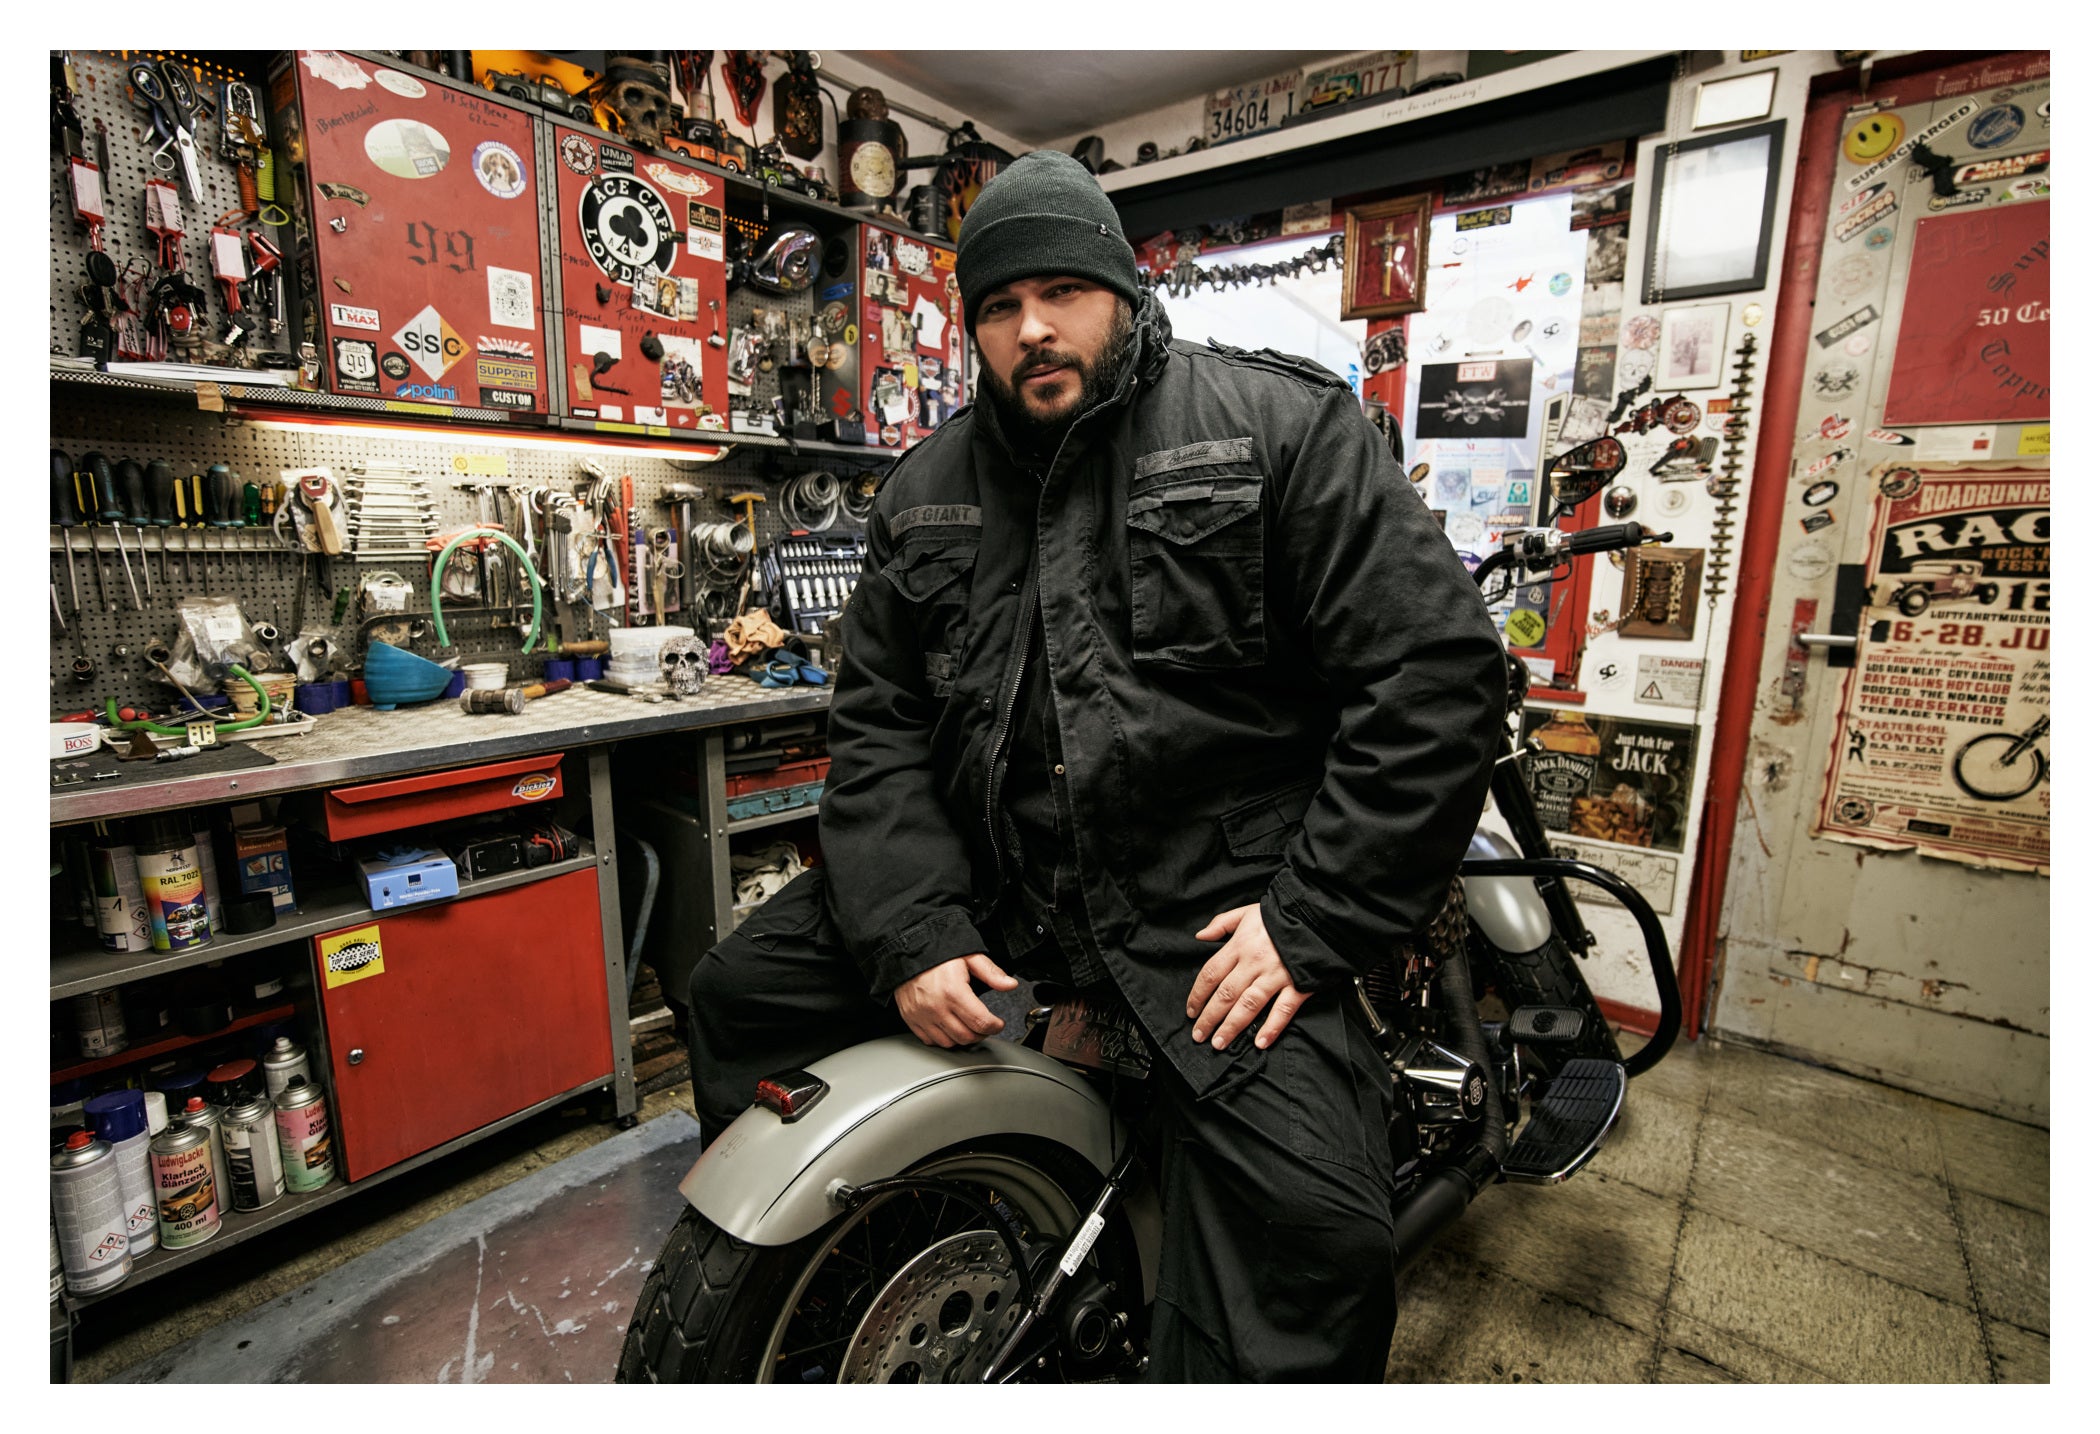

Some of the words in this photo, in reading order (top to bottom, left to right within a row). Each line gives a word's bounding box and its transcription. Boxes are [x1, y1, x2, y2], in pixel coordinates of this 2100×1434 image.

[1212, 97, 1269, 139] 34604
[601, 146, 633, 161] UMAP
[1850, 104, 1971, 188] SUPERCHARGED
[1954, 152, 2047, 185] CRANE
[592, 179, 629, 204] ACE
[638, 189, 670, 242] CAFE
[347, 313, 378, 326] MAX
[1976, 307, 2009, 327] 50
[346, 354, 367, 374] 99
[1461, 365, 1492, 379] FTW
[410, 383, 456, 400] polini
[492, 390, 532, 406] CUSTOM
[922, 507, 972, 522] GIANT
[1997, 560, 2050, 572] FEST
[1599, 664, 1618, 680] SC
[1660, 658, 1703, 670] DANGER
[1866, 663, 1884, 673] LOS
[1887, 665, 1909, 674] RAW
[1912, 667, 1941, 677] MEAT
[1948, 669, 1969, 680] CRY
[1972, 671, 2013, 683] BABIES
[1950, 660, 1978, 671] LITTLE
[1864, 673, 1887, 684] RAY
[1889, 675, 1944, 689] COLLINS
[1946, 680, 1973, 691] HOT
[1974, 682, 2011, 695] CLUB
[1861, 684, 1910, 697] BOOZED
[1920, 689, 1944, 700] THE
[1948, 692, 2008, 706] NOMADS
[1860, 694, 1889, 706] THE
[1893, 697, 2005, 717] BERSERKERZ
[1859, 705, 1932, 719] TEENAGE
[1935, 712, 2004, 726] TERROR
[1857, 720, 1913, 732] STARTER
[1915, 723, 1948, 735] GIRL
[64, 737, 93, 751] BOSS
[1614, 732, 1636, 747] Just
[1638, 735, 1655, 749] Ask
[1656, 737, 1674, 751] For
[1870, 731, 1948, 746] CONTEST
[1534, 758, 1556, 772] JACK
[1612, 745, 1669, 776] JACK
[519, 781, 552, 793] Dickies
[160, 877, 179, 886] RAL
[182, 871, 199, 881] 7022
[331, 957, 343, 966] TOP
[345, 953, 357, 962] GAS
[359, 948, 377, 958] SERIE
[161, 1169, 208, 1189] Glänzend
[162, 1163, 206, 1181] Klarlack
[174, 1221, 193, 1232] 400
[195, 1214, 207, 1226] ml
